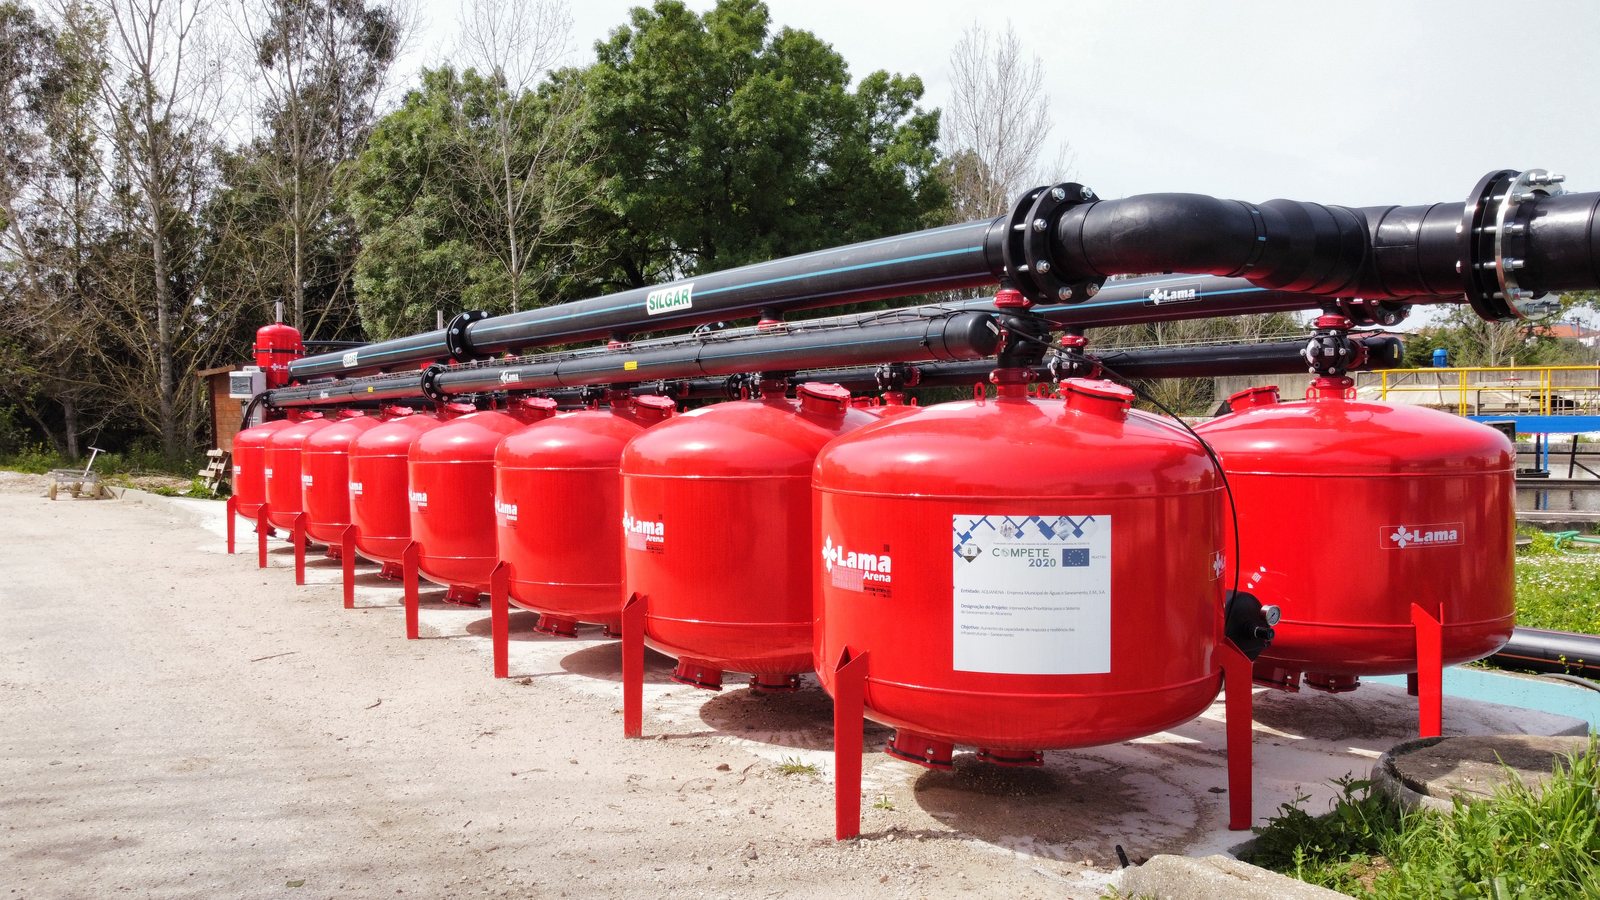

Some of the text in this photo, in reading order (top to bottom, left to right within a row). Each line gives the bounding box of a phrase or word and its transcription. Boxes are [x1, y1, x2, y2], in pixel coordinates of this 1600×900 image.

[648, 288, 689, 310] SILGAR
[1163, 288, 1195, 300] Lama
[630, 516, 664, 536] Lama
[1413, 529, 1458, 543] Lama
[837, 545, 892, 573] Lama
[992, 547, 1050, 558] COMPETE
[1028, 558, 1057, 568] 2020
[863, 570, 892, 583] Arena
